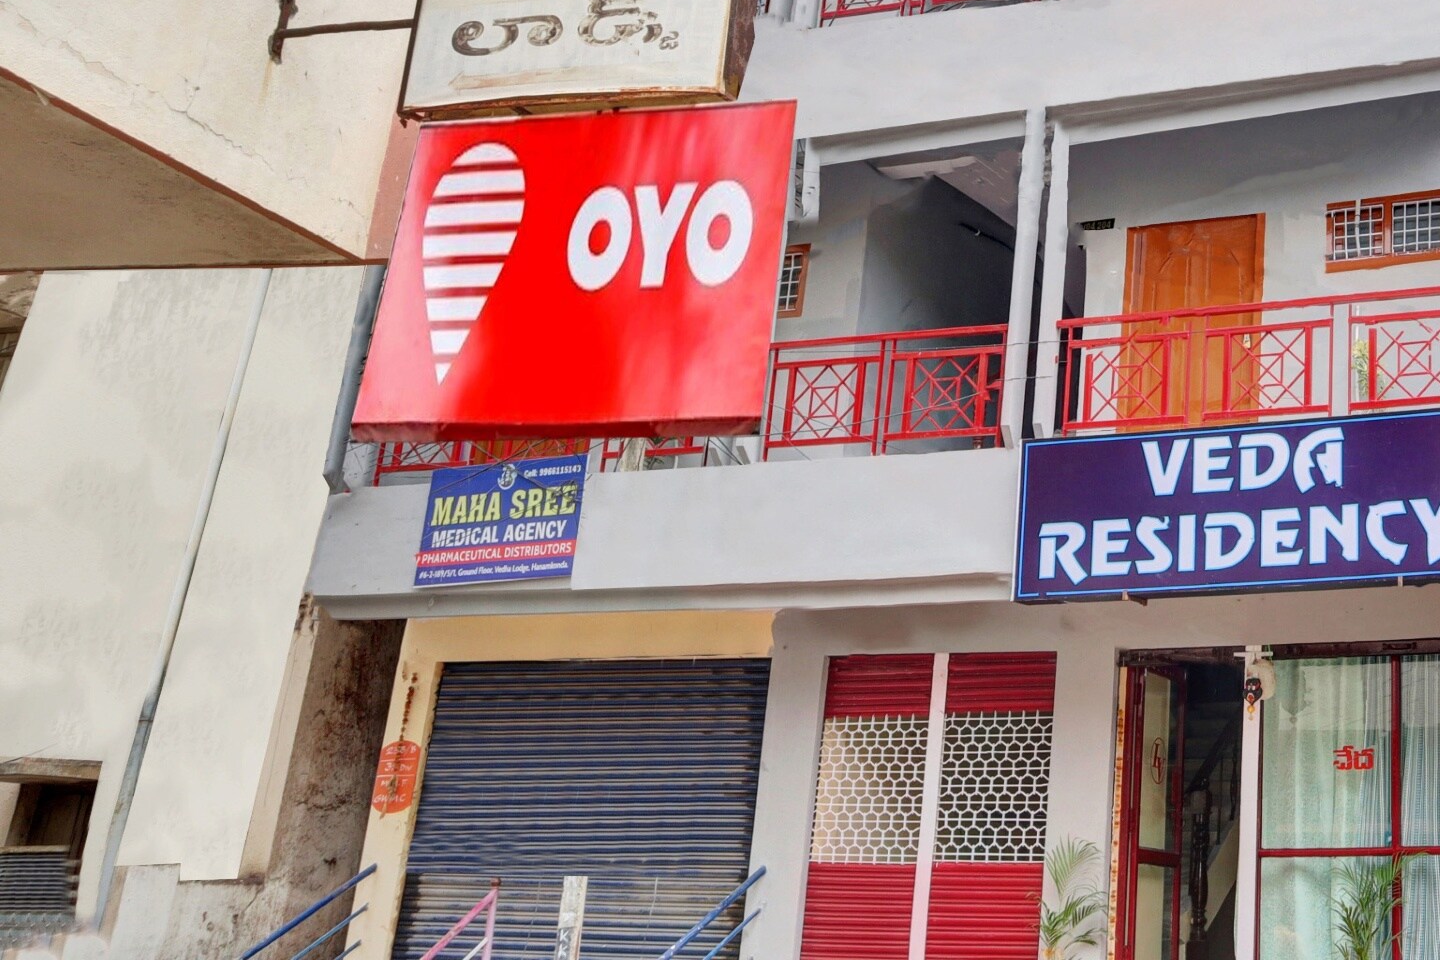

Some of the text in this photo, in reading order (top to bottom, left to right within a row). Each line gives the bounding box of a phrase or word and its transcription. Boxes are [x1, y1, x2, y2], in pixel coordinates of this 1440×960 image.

[567, 179, 754, 292] OYO
[1141, 427, 1345, 497] VEDA
[430, 485, 578, 527] MAHA SREE
[421, 542, 572, 565] PHARMACEUTICAL DISTRIBUTORS
[431, 520, 567, 548] MEDICAL AGENCY
